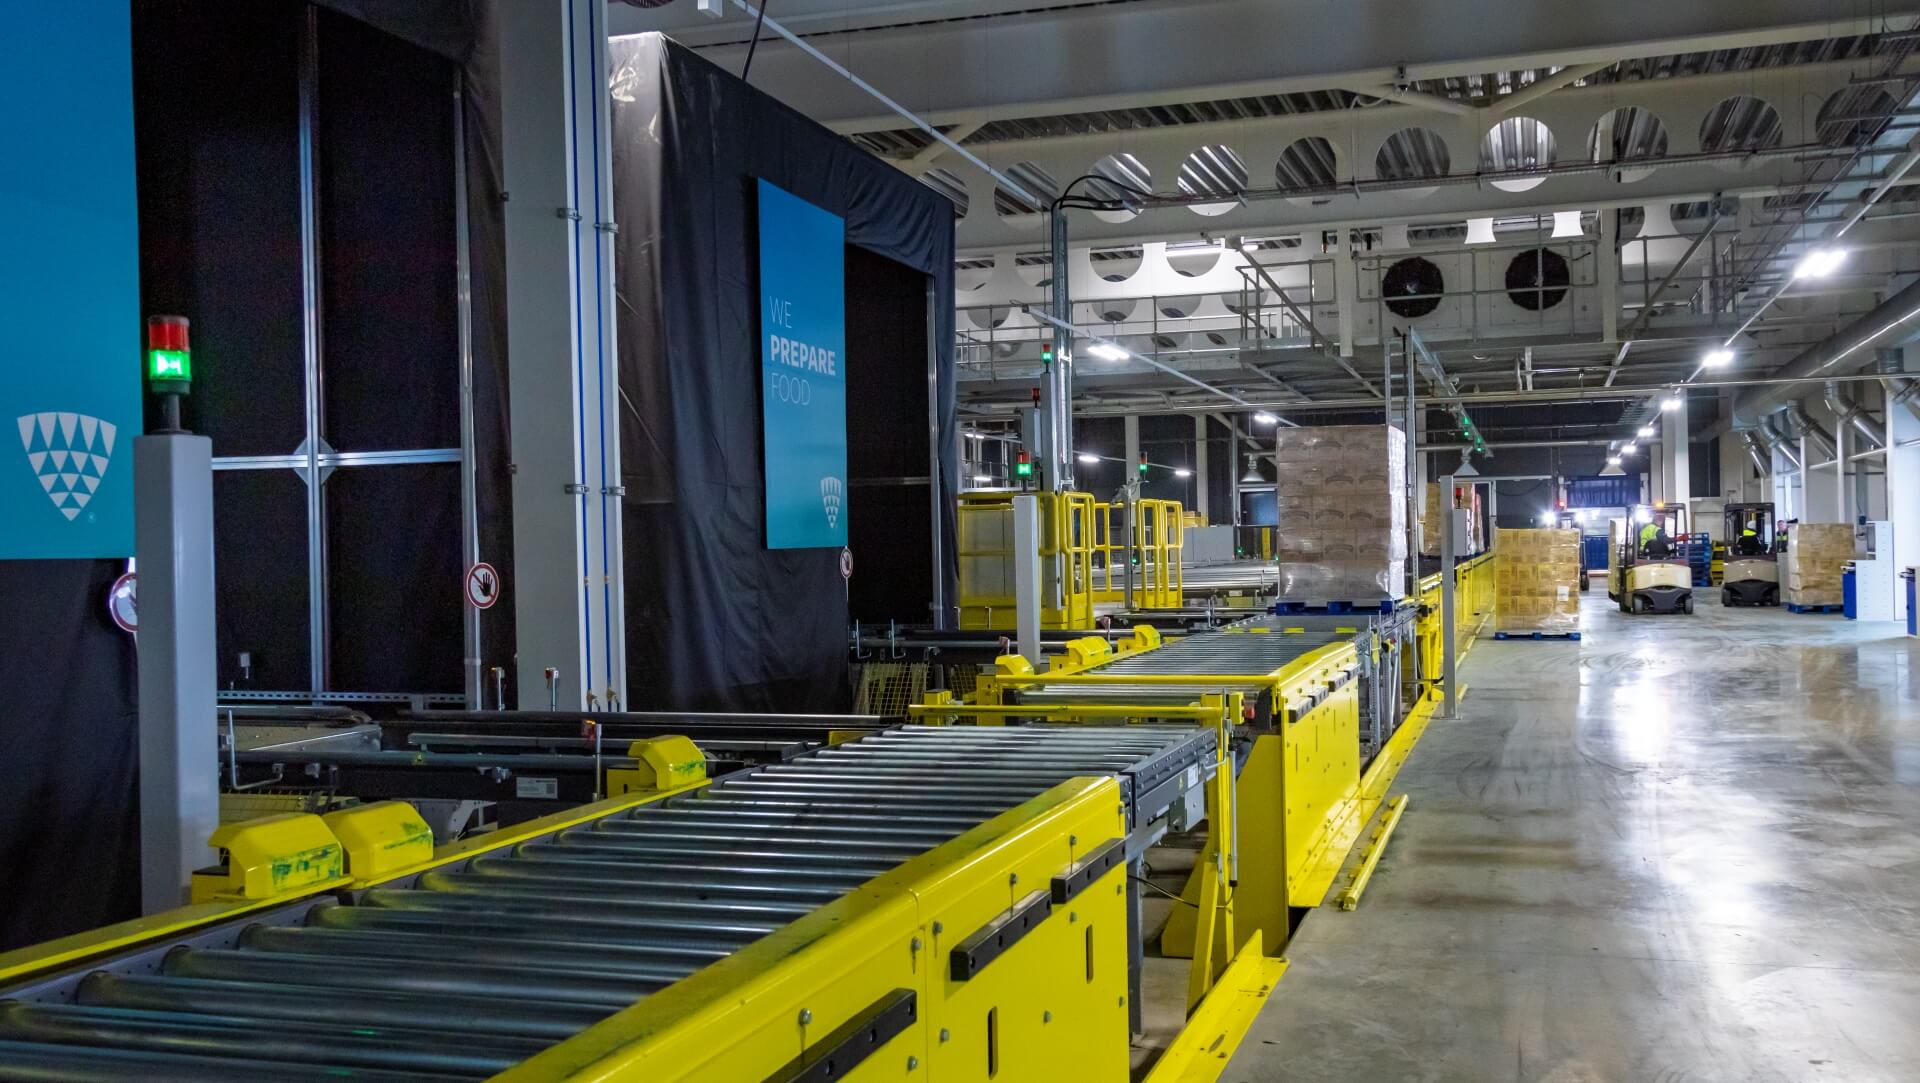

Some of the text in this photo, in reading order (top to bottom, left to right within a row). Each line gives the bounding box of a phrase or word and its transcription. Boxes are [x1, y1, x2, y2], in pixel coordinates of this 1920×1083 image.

[769, 295, 793, 329] WE
[770, 334, 836, 376] PREPARE
[771, 372, 811, 406] FOOD
